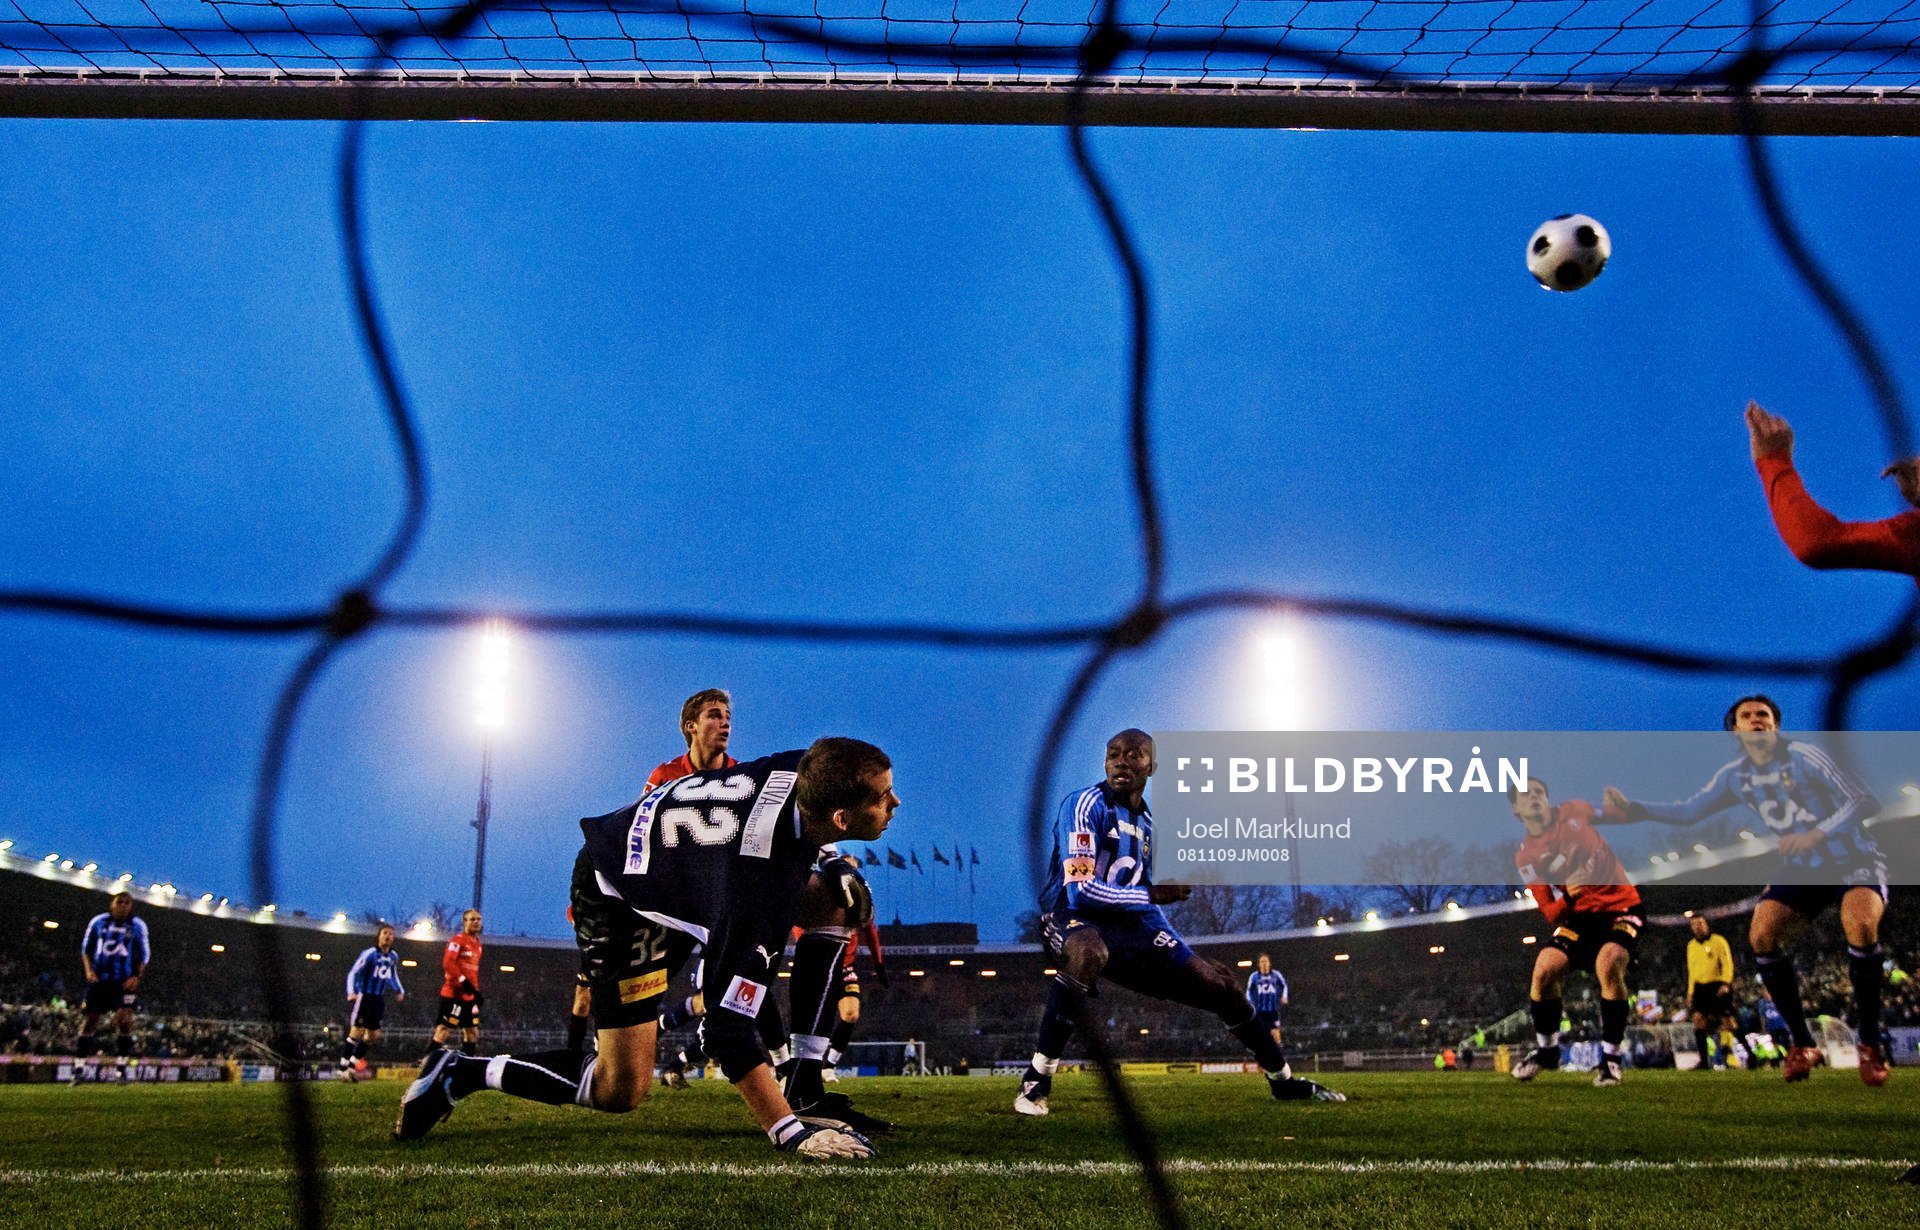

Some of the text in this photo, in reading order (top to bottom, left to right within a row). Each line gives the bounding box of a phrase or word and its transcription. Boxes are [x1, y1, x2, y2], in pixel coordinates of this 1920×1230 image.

[661, 773, 757, 848] 32
[97, 938, 129, 957] ICA
[631, 924, 668, 967] 32
[374, 966, 392, 980] ICA
[1257, 983, 1276, 994] ICA
